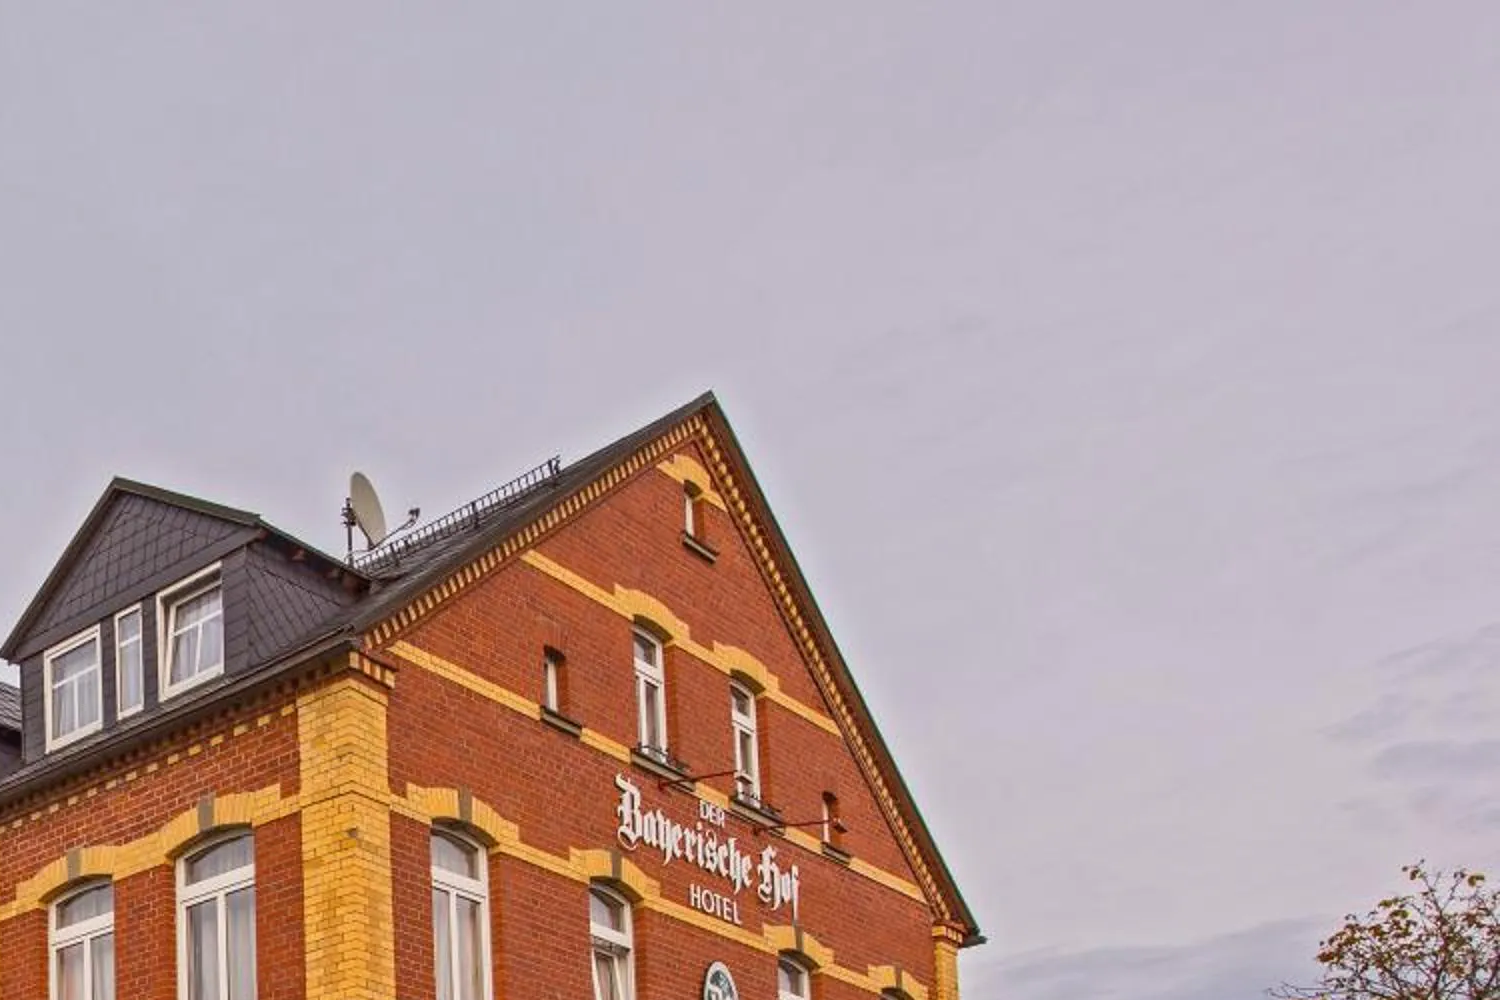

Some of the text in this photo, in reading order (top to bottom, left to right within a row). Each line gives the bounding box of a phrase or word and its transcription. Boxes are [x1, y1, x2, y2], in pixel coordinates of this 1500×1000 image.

[700, 801, 726, 828] DER
[615, 772, 799, 921] Bayerische Hof
[689, 884, 743, 925] HOTEL
